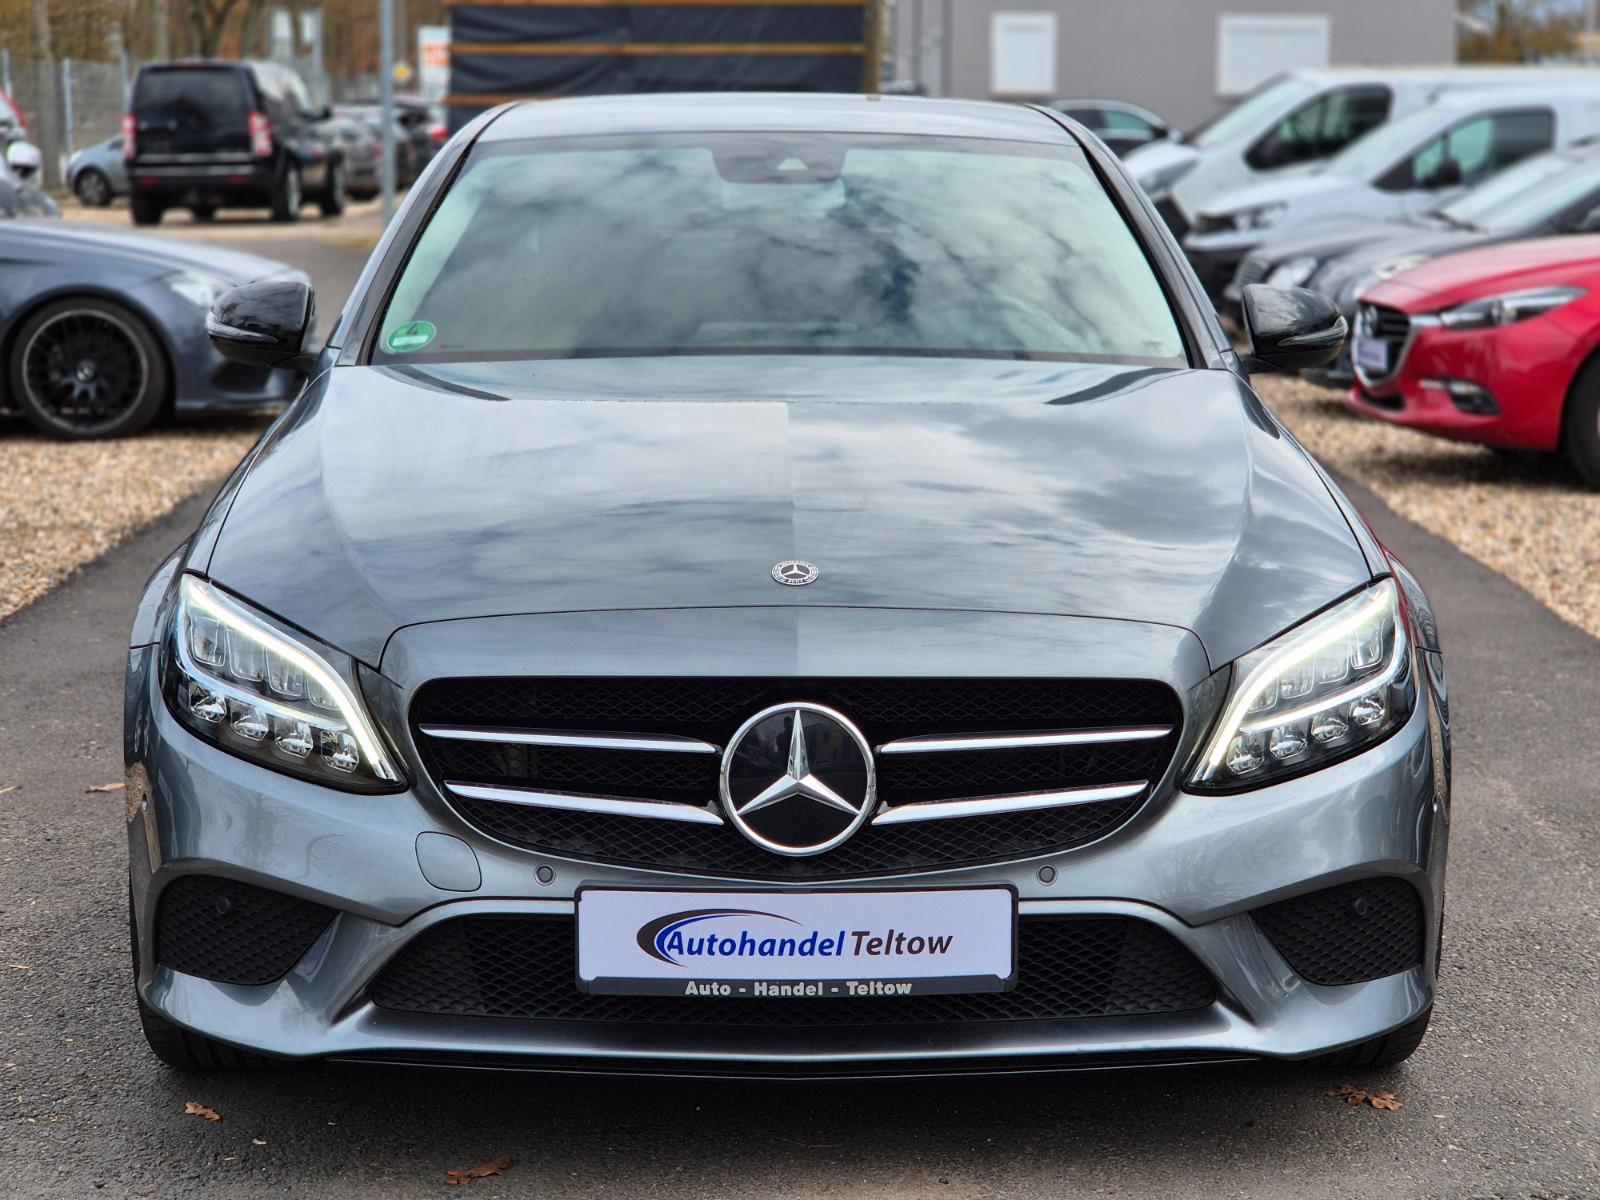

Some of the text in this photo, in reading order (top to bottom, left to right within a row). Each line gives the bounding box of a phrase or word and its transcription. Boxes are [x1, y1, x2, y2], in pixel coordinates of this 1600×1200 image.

[666, 929, 954, 957] Autohandel Teltow
[685, 980, 731, 996] Auto
[754, 981, 823, 996] Handel
[846, 980, 912, 996] Teltow
